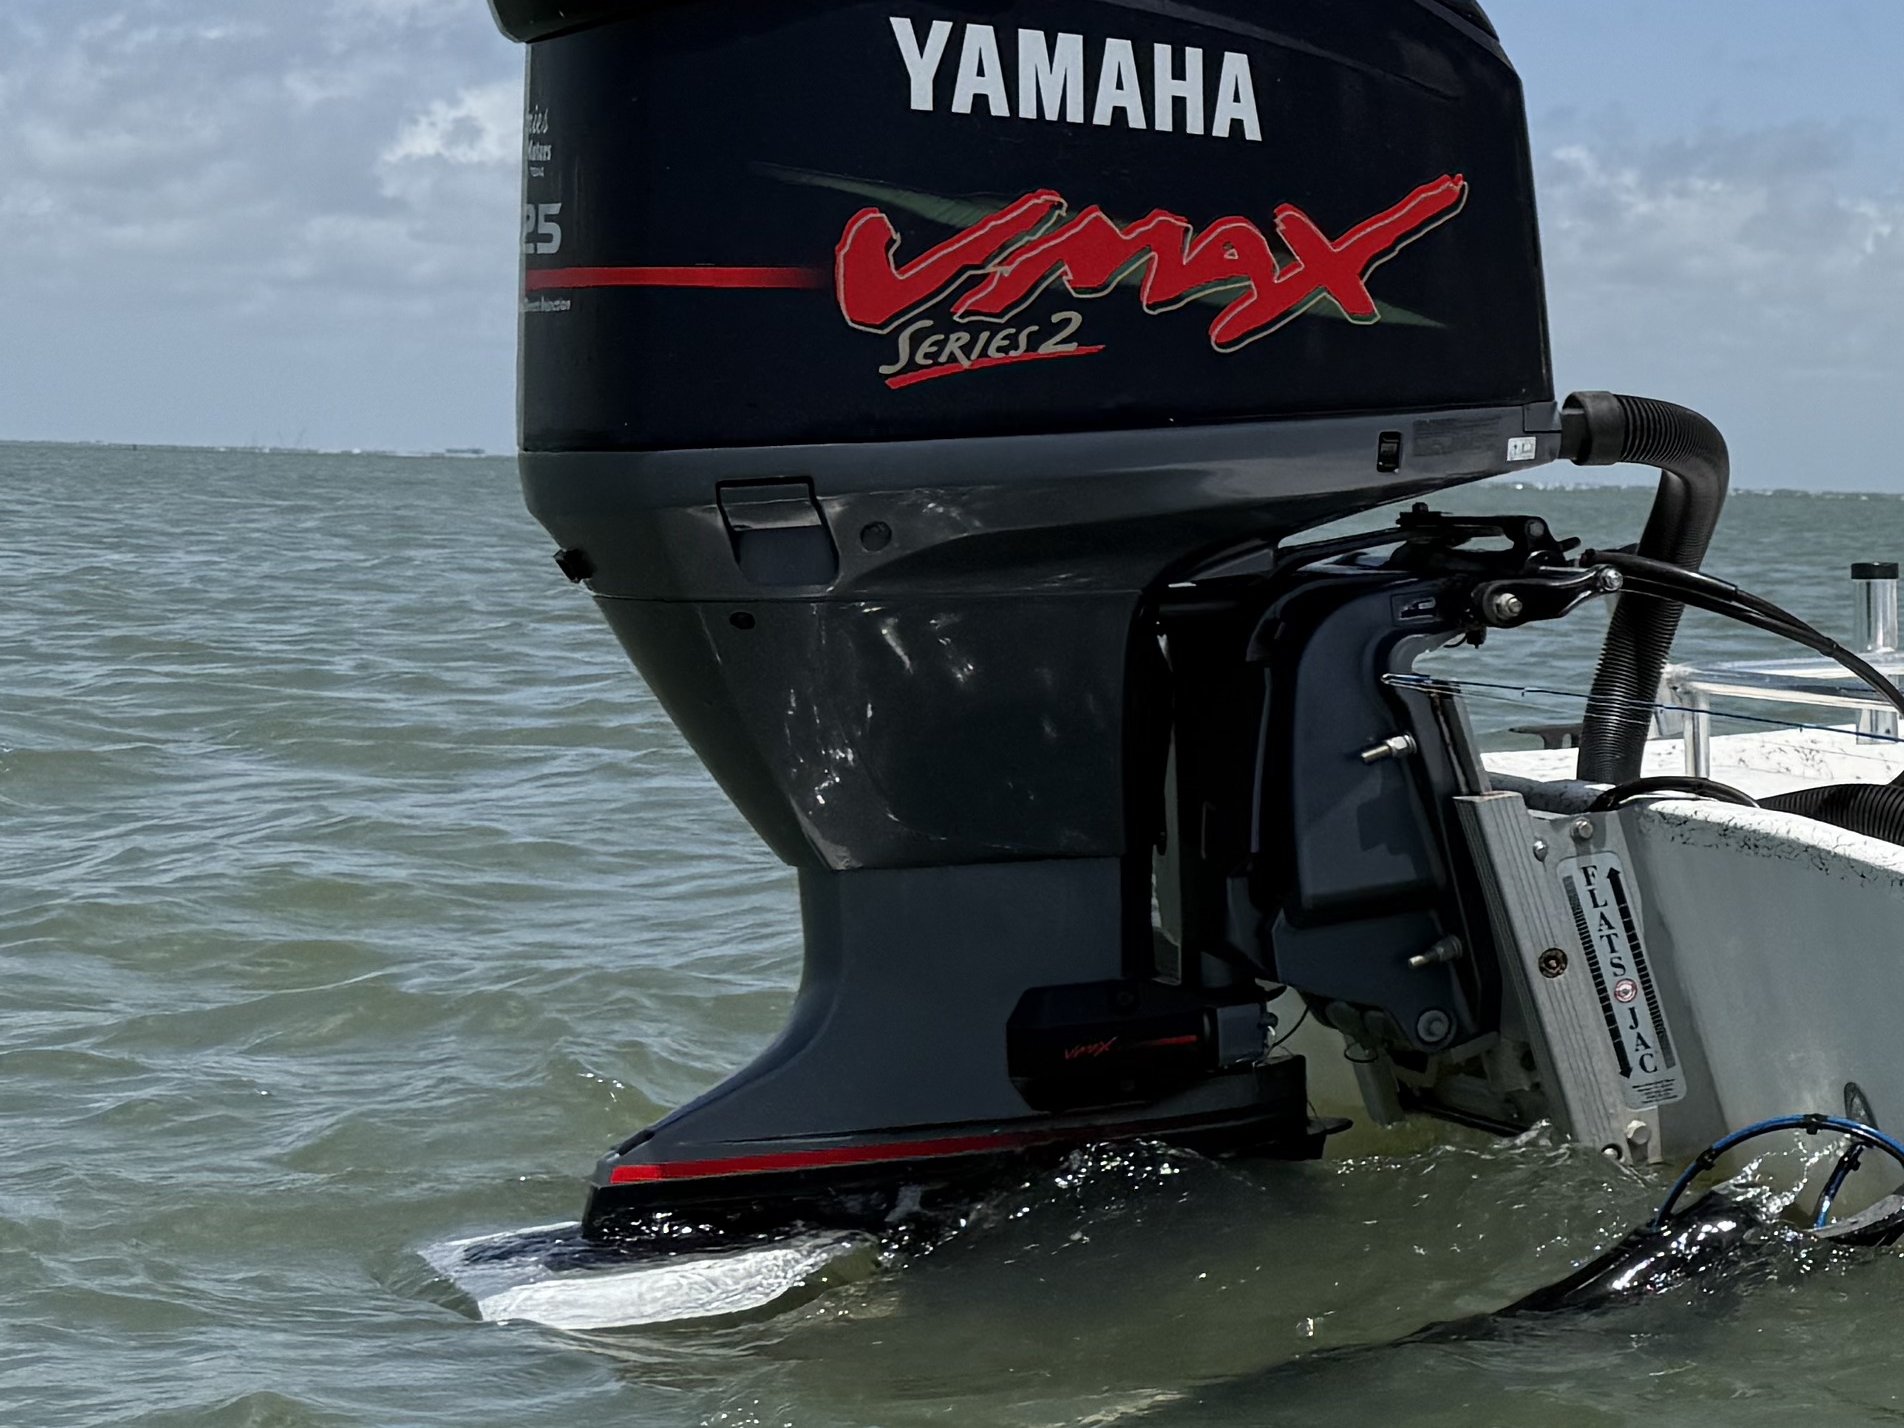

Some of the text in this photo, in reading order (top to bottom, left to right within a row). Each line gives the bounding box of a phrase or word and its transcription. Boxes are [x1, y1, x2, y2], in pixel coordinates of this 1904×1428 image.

[889, 16, 1262, 141] YAMAHA
[1036, 311, 1083, 354] 2
[1581, 865, 1627, 977] FLATS
[1628, 1007, 1658, 1073] JAC
